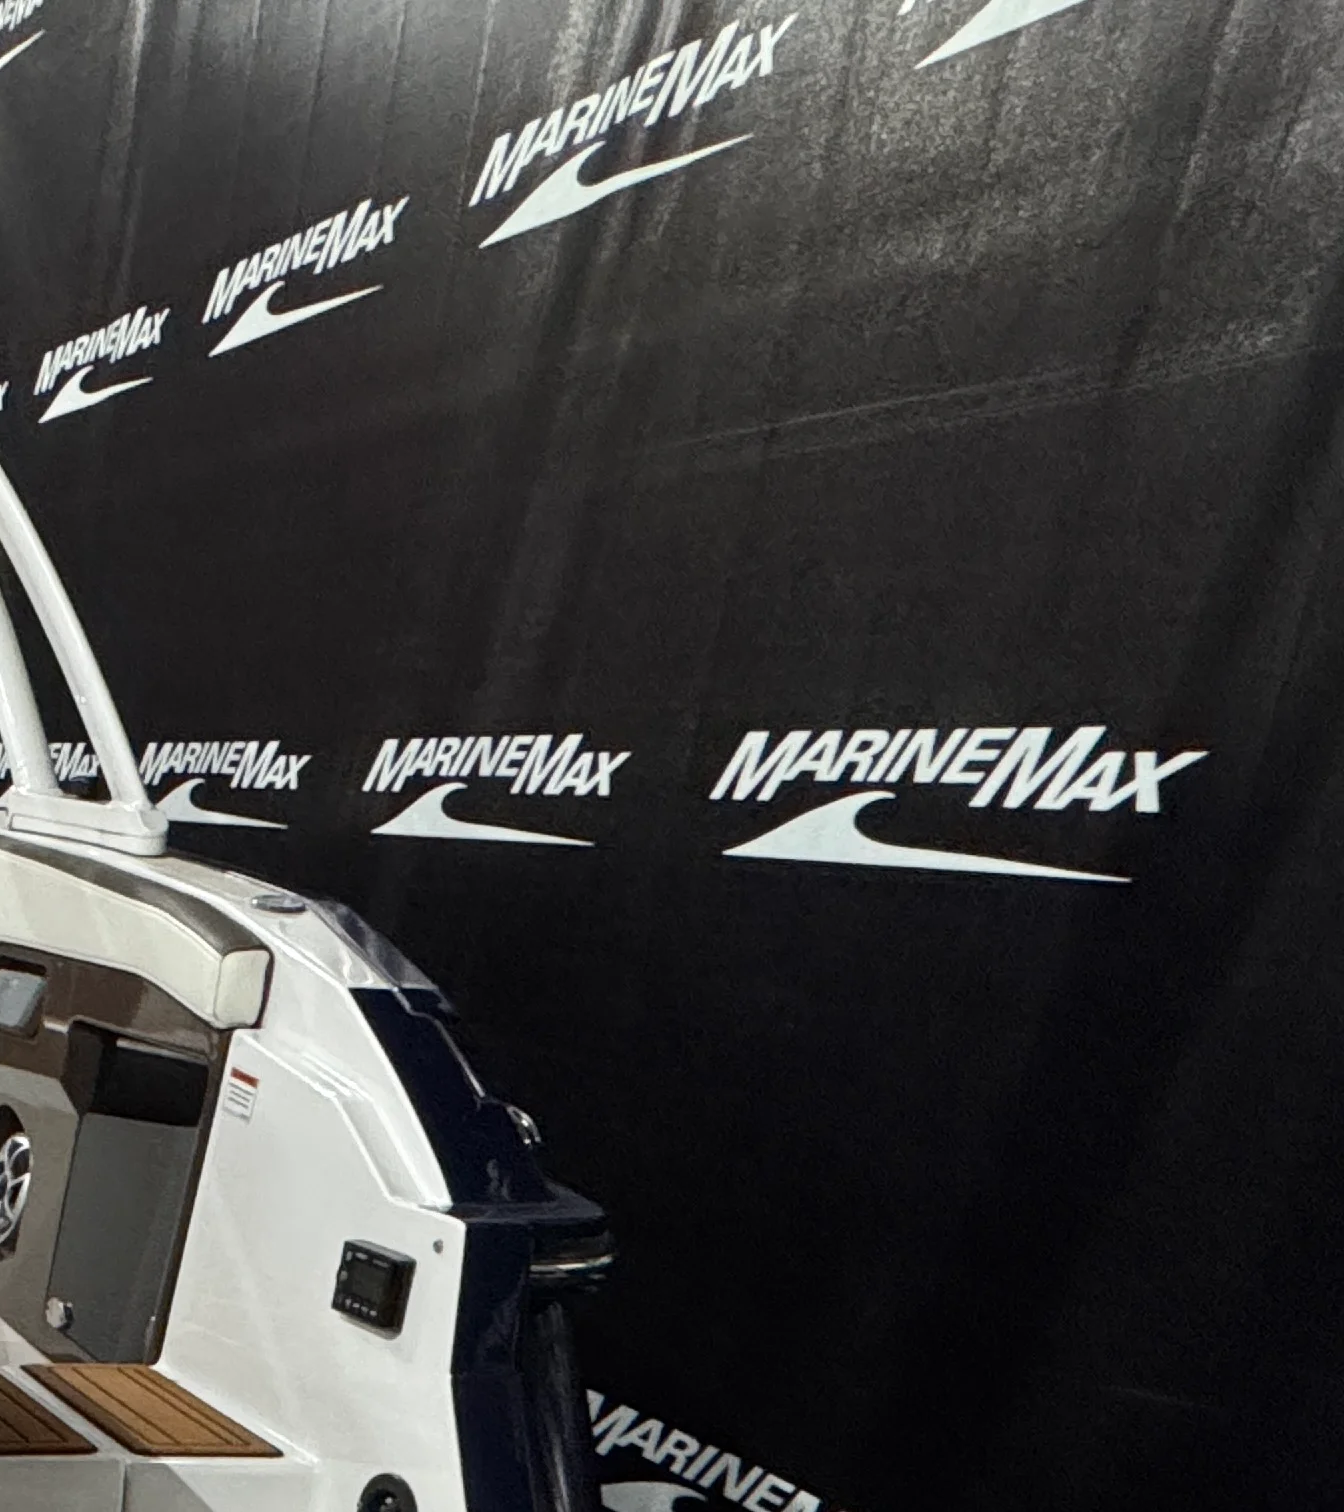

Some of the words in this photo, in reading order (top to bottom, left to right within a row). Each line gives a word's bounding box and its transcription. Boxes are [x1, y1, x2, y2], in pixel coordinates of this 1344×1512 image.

[469, 13, 798, 208] MARINEMAX
[202, 196, 410, 324] MARINEMAX
[34, 306, 170, 395] MARINEMAX
[140, 740, 311, 790] MARINEMAX
[363, 733, 632, 797] MARINEMAX
[710, 726, 1210, 813] MARINEMAX
